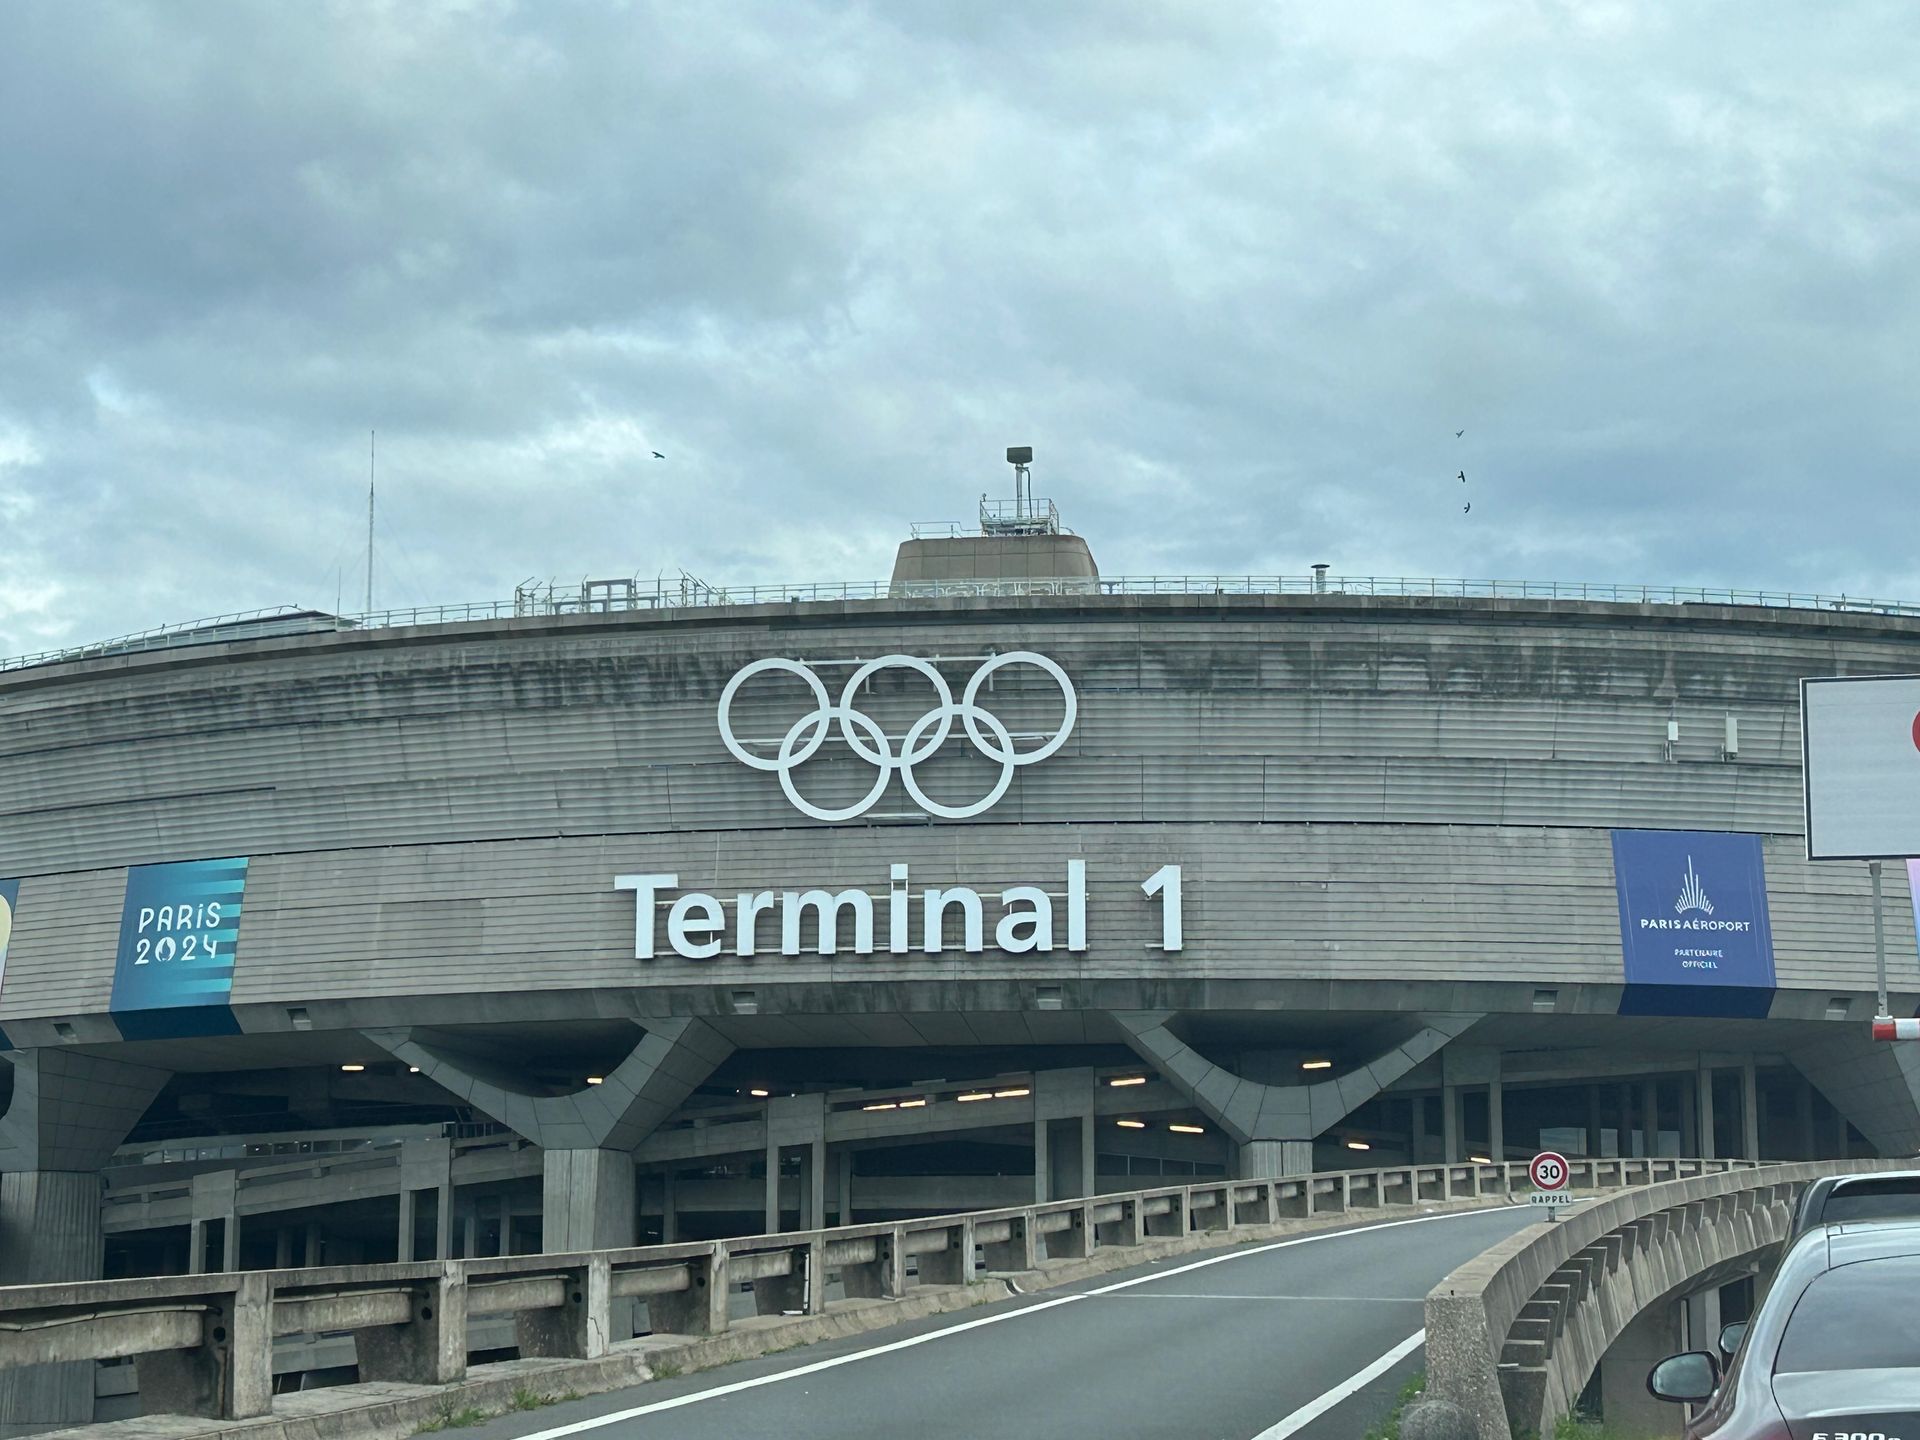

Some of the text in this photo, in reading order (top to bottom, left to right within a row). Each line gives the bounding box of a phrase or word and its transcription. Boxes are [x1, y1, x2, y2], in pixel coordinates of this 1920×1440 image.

[614, 859, 1182, 959] Terminal 1
[134, 934, 217, 965] 2024
[1539, 1164, 1560, 1179] 30
[1531, 1195, 1570, 1204] RAPPEL
